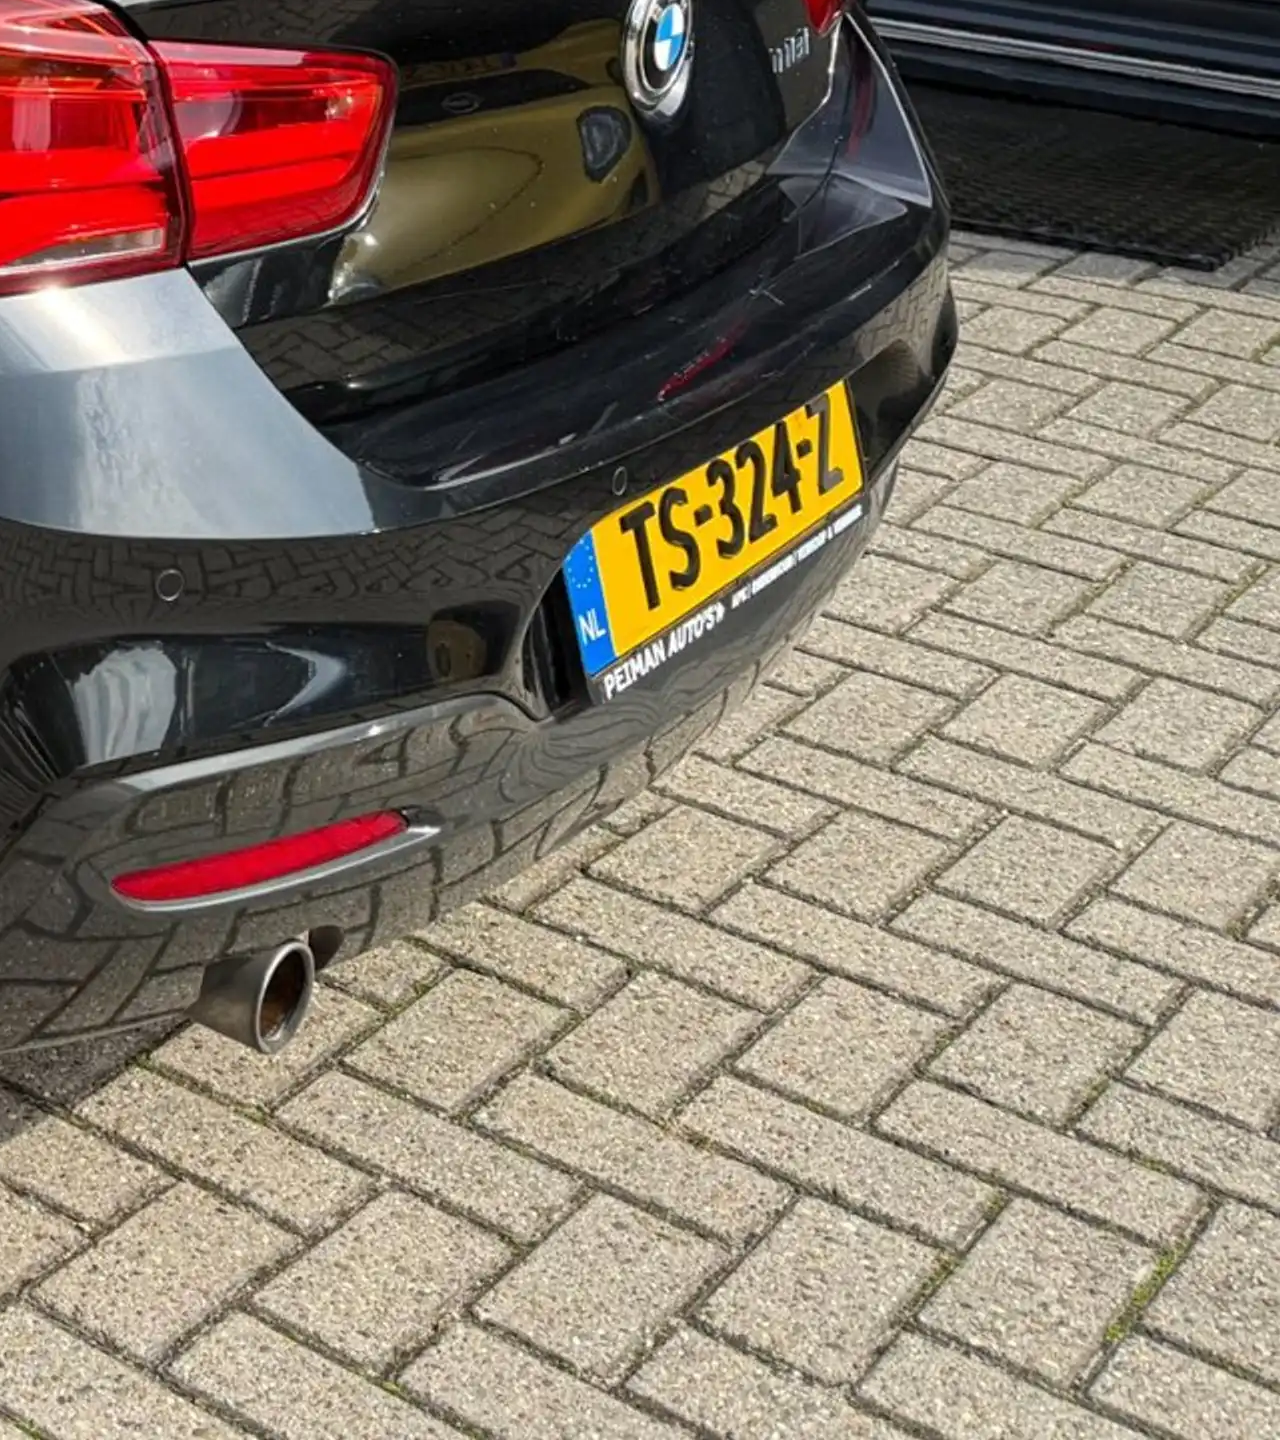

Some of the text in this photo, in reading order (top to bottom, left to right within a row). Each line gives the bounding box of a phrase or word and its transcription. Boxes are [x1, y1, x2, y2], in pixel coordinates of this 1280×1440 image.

[619, 393, 844, 611] TS-324-Z
[578, 608, 607, 646] NL
[603, 640, 667, 701] PEIMAN
